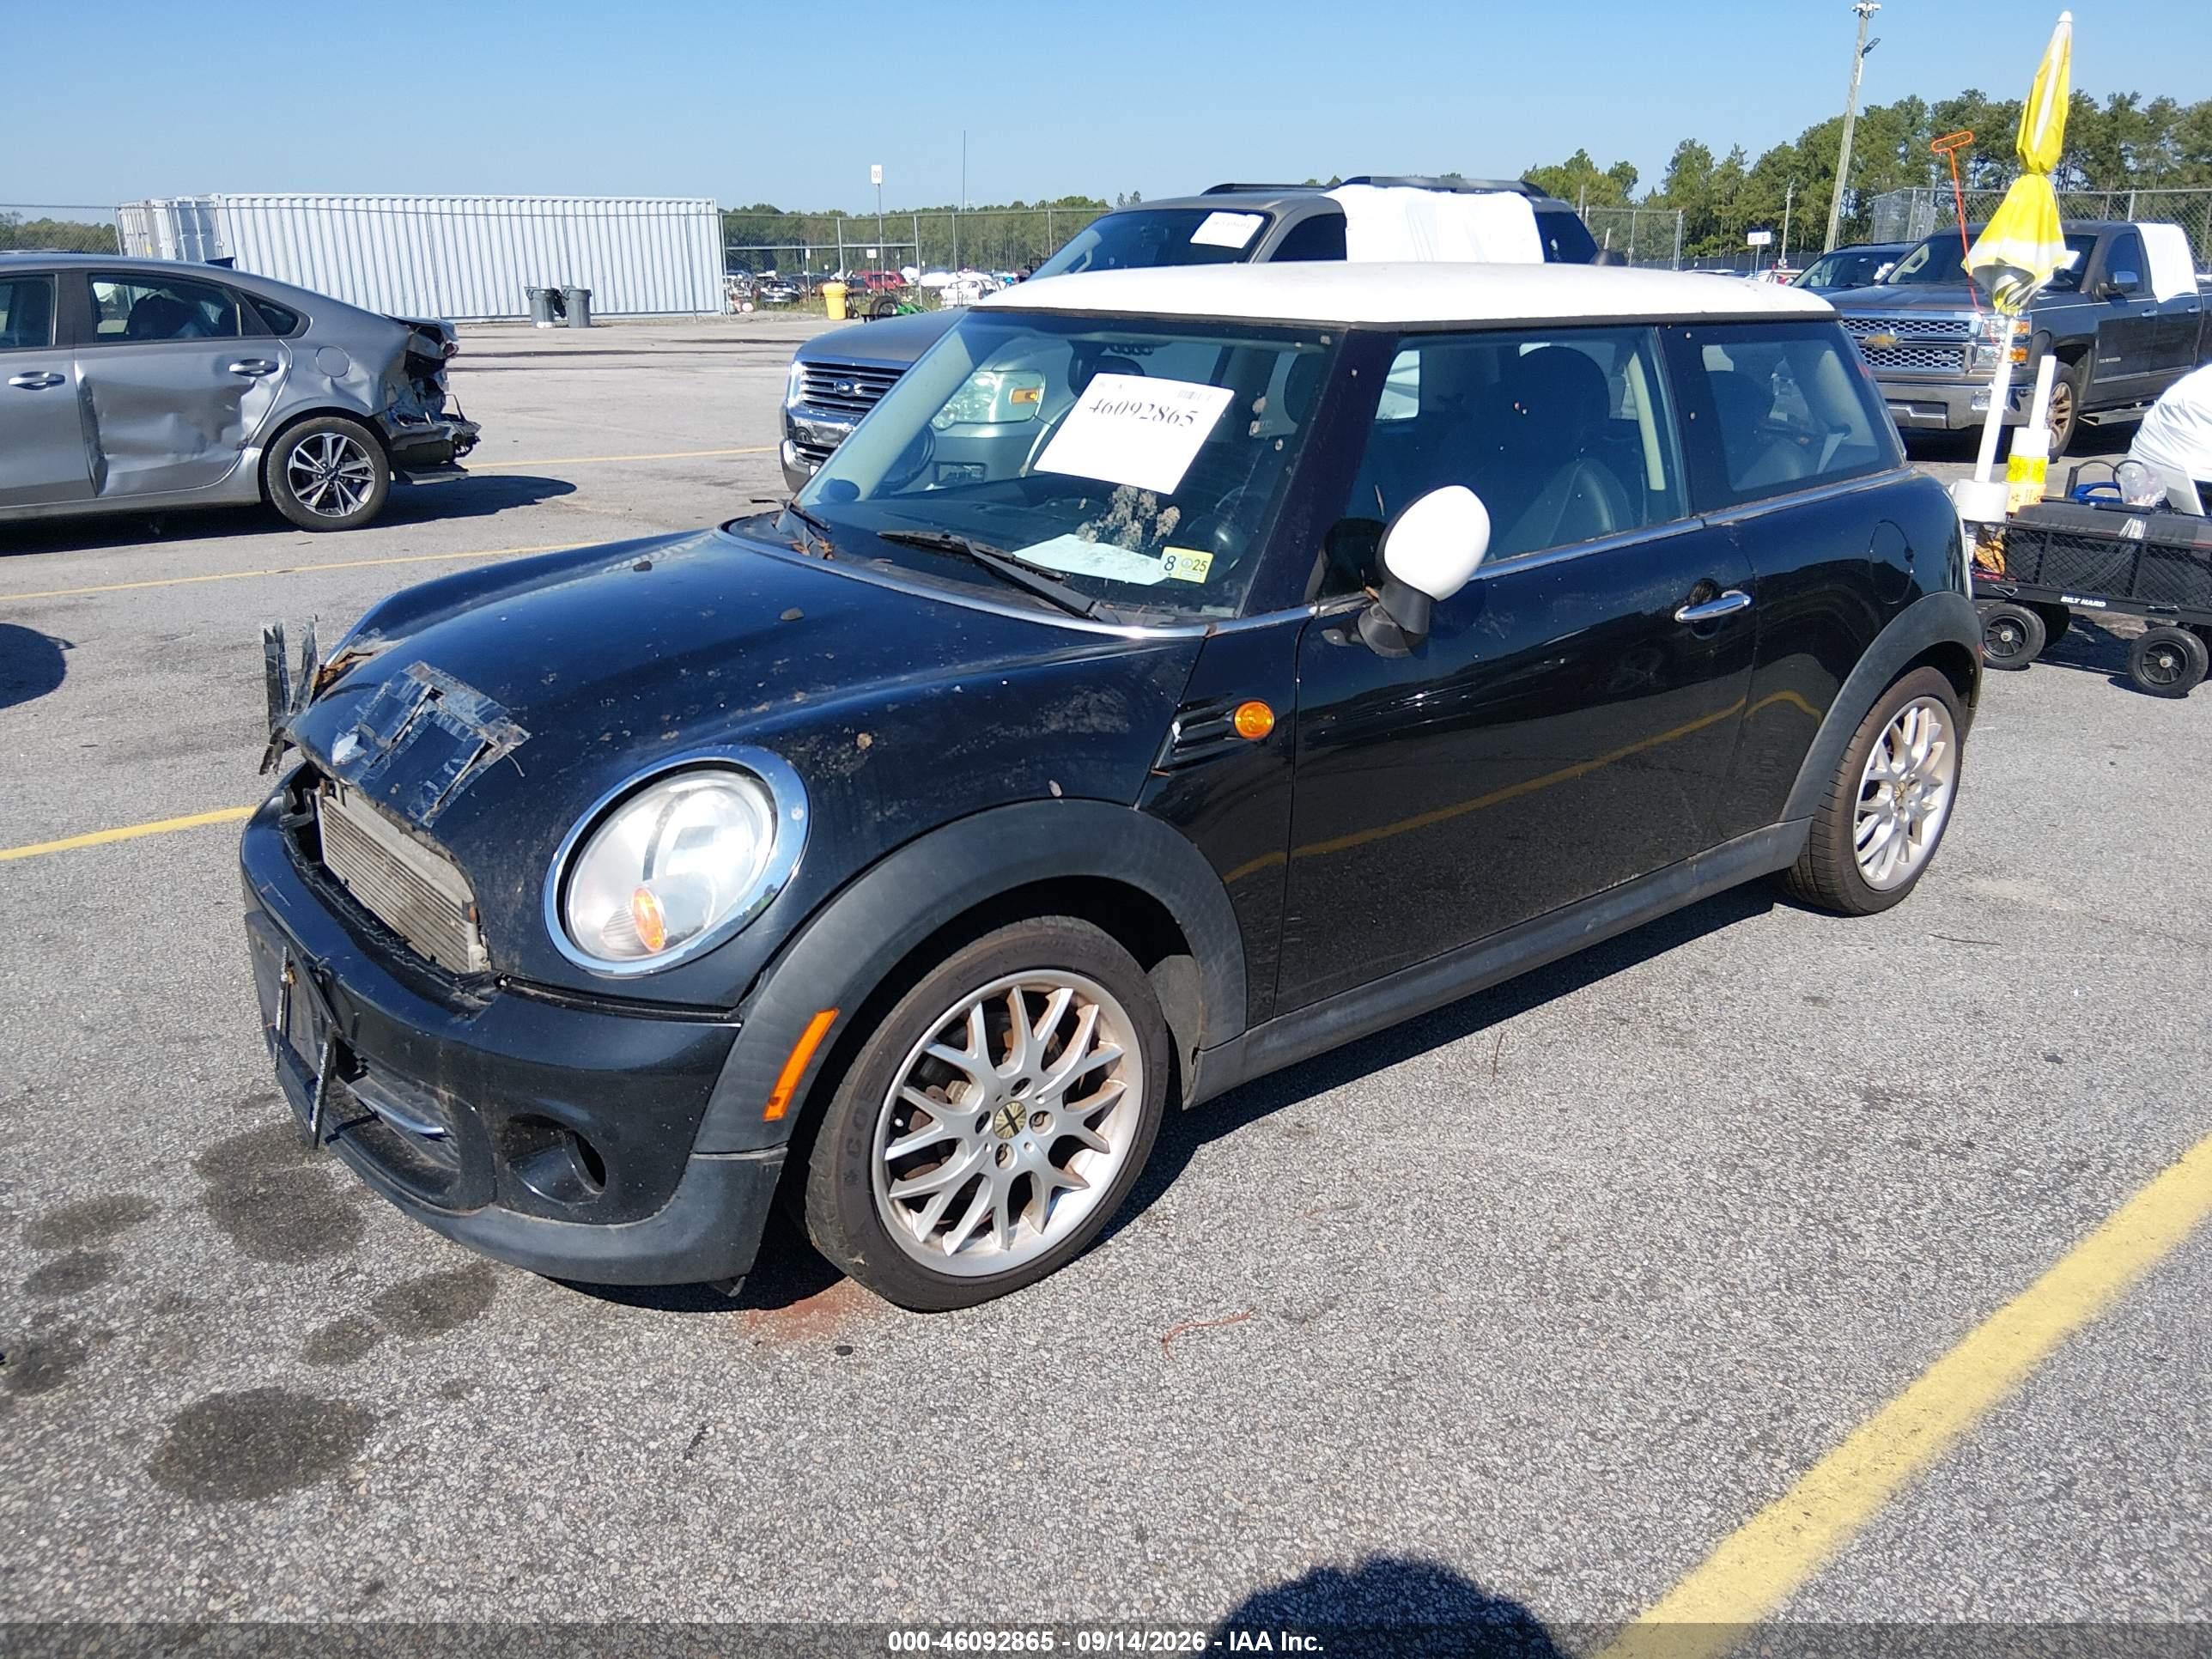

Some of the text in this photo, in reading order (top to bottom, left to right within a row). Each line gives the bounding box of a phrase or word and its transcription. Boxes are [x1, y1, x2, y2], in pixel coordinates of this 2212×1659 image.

[1089, 398, 1199, 428] 46092865
[1164, 555, 1208, 573] 8 25
[2080, 599, 2106, 608] HARD
